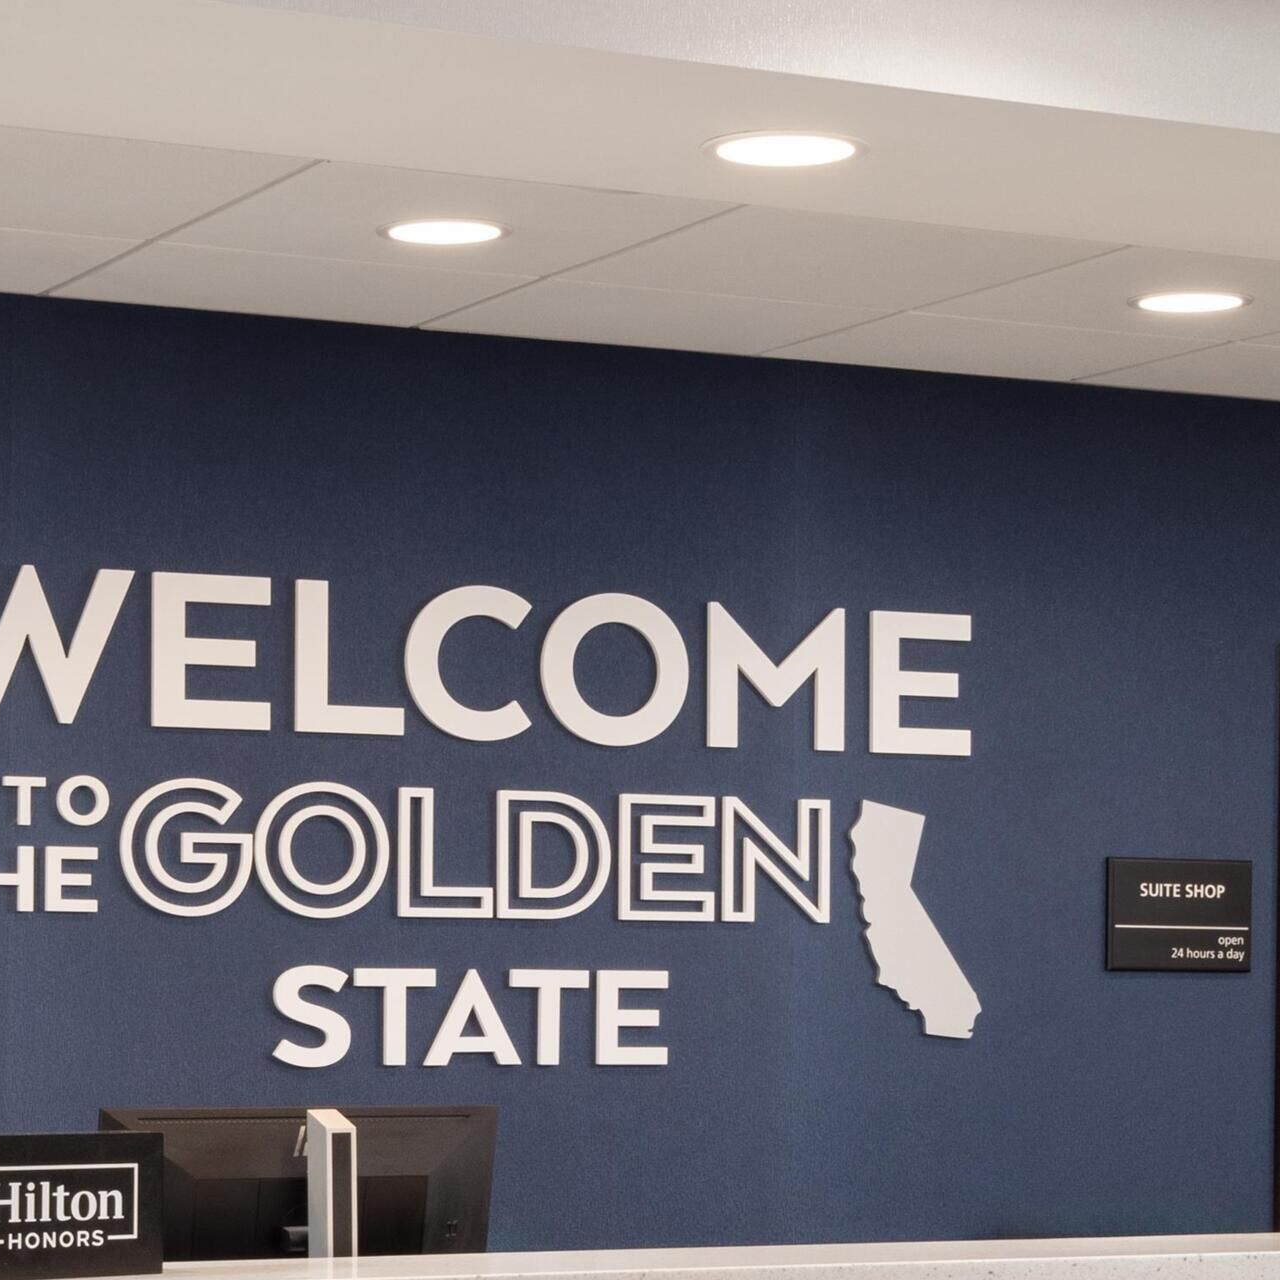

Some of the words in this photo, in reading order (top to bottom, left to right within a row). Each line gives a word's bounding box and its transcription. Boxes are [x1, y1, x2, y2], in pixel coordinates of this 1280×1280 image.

[2, 774, 111, 826] TO
[119, 777, 832, 924] GOLDEN
[1140, 882, 1181, 898] SUITE
[1185, 883, 1226, 899] SHOP
[1218, 936, 1244, 948] open
[1171, 947, 1184, 959] 24
[1186, 948, 1215, 960] hours
[1217, 951, 1224, 960] a
[1226, 948, 1245, 962] day
[272, 964, 670, 1068] STATE
[8, 1229, 105, 1250] HONORS
